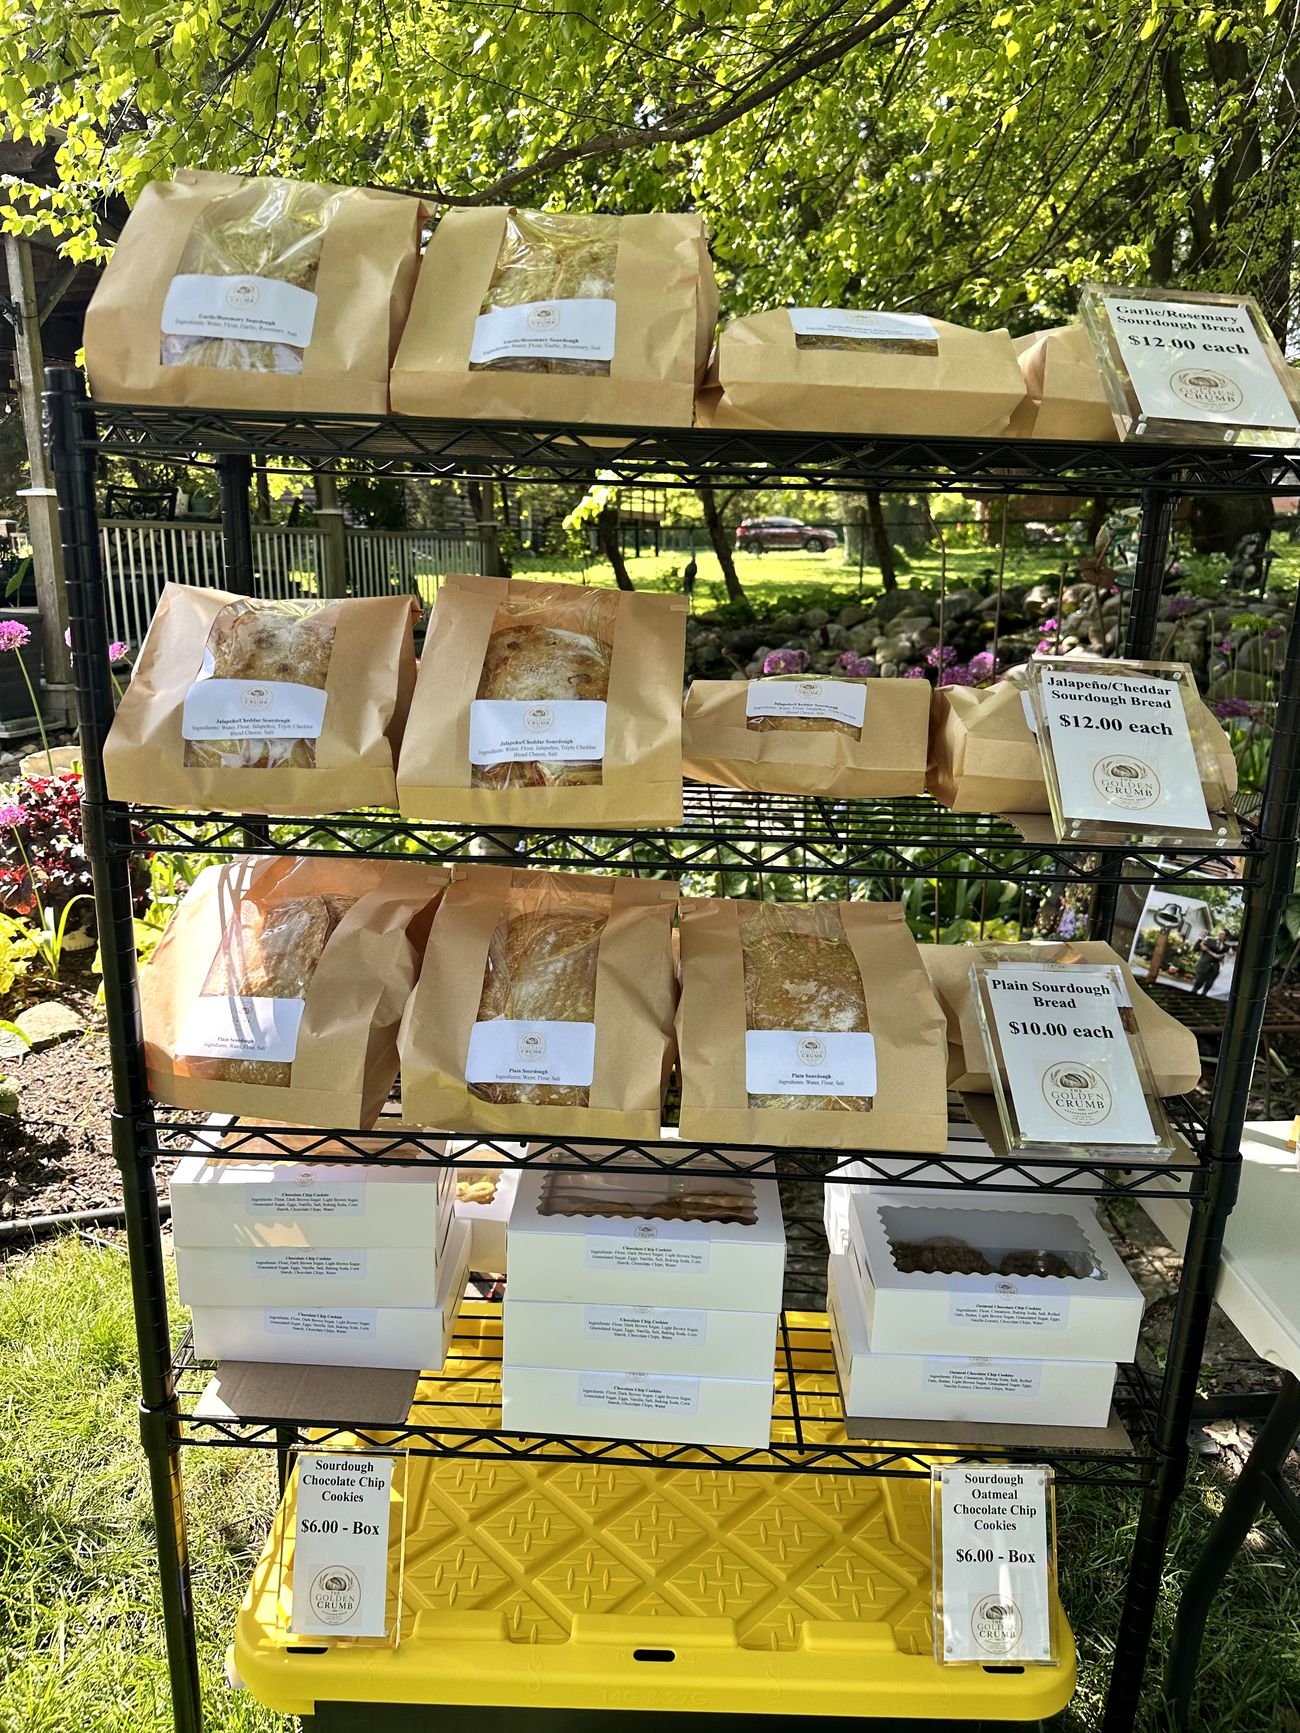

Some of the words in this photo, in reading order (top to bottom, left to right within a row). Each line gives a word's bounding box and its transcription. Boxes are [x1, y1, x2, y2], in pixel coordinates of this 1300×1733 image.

[1117, 306, 1238, 324] Garlic/Rosemary
[1118, 316, 1196, 330] Sourdough
[1202, 322, 1245, 333] Bread
[1129, 335, 1195, 350] $12.00
[1203, 344, 1249, 354] each
[1184, 393, 1234, 403] CRUMB
[1048, 677, 1171, 695] Jalapeño/Cheddar
[1052, 690, 1126, 706] Sourdough
[1131, 697, 1171, 708] Bread
[1060, 715, 1122, 731] $12.00
[1129, 723, 1173, 735] each
[1102, 779, 1153, 789] GOLDEN
[1105, 787, 1152, 796] CRUMB
[992, 979, 1028, 991] Plain
[1033, 981, 1110, 997] Sourdough
[1034, 997, 1076, 1008] Bread
[1009, 1021, 1067, 1036] $10.00
[1073, 1026, 1114, 1038] each
[1052, 1092, 1104, 1100] GOLDEN
[1056, 1099, 1104, 1109] CRUMB
[316, 1460, 374, 1474] Sourdough
[303, 1475, 355, 1487] Chocolate
[359, 1477, 385, 1490] Chip
[965, 1474, 1023, 1486] Sourdough
[322, 1491, 363, 1502] Cookies
[972, 1489, 1017, 1499] Oatmeal
[954, 1504, 1007, 1515] Chocolate
[1010, 1505, 1036, 1517] Chip
[301, 1519, 338, 1534] $6.00
[353, 1522, 380, 1535] Box
[974, 1520, 1016, 1530] Cookies
[956, 1549, 993, 1562] $6.00
[1009, 1550, 1036, 1563] Box
[316, 1594, 354, 1602] GOLDEN
[317, 1602, 353, 1610] CRUMB
